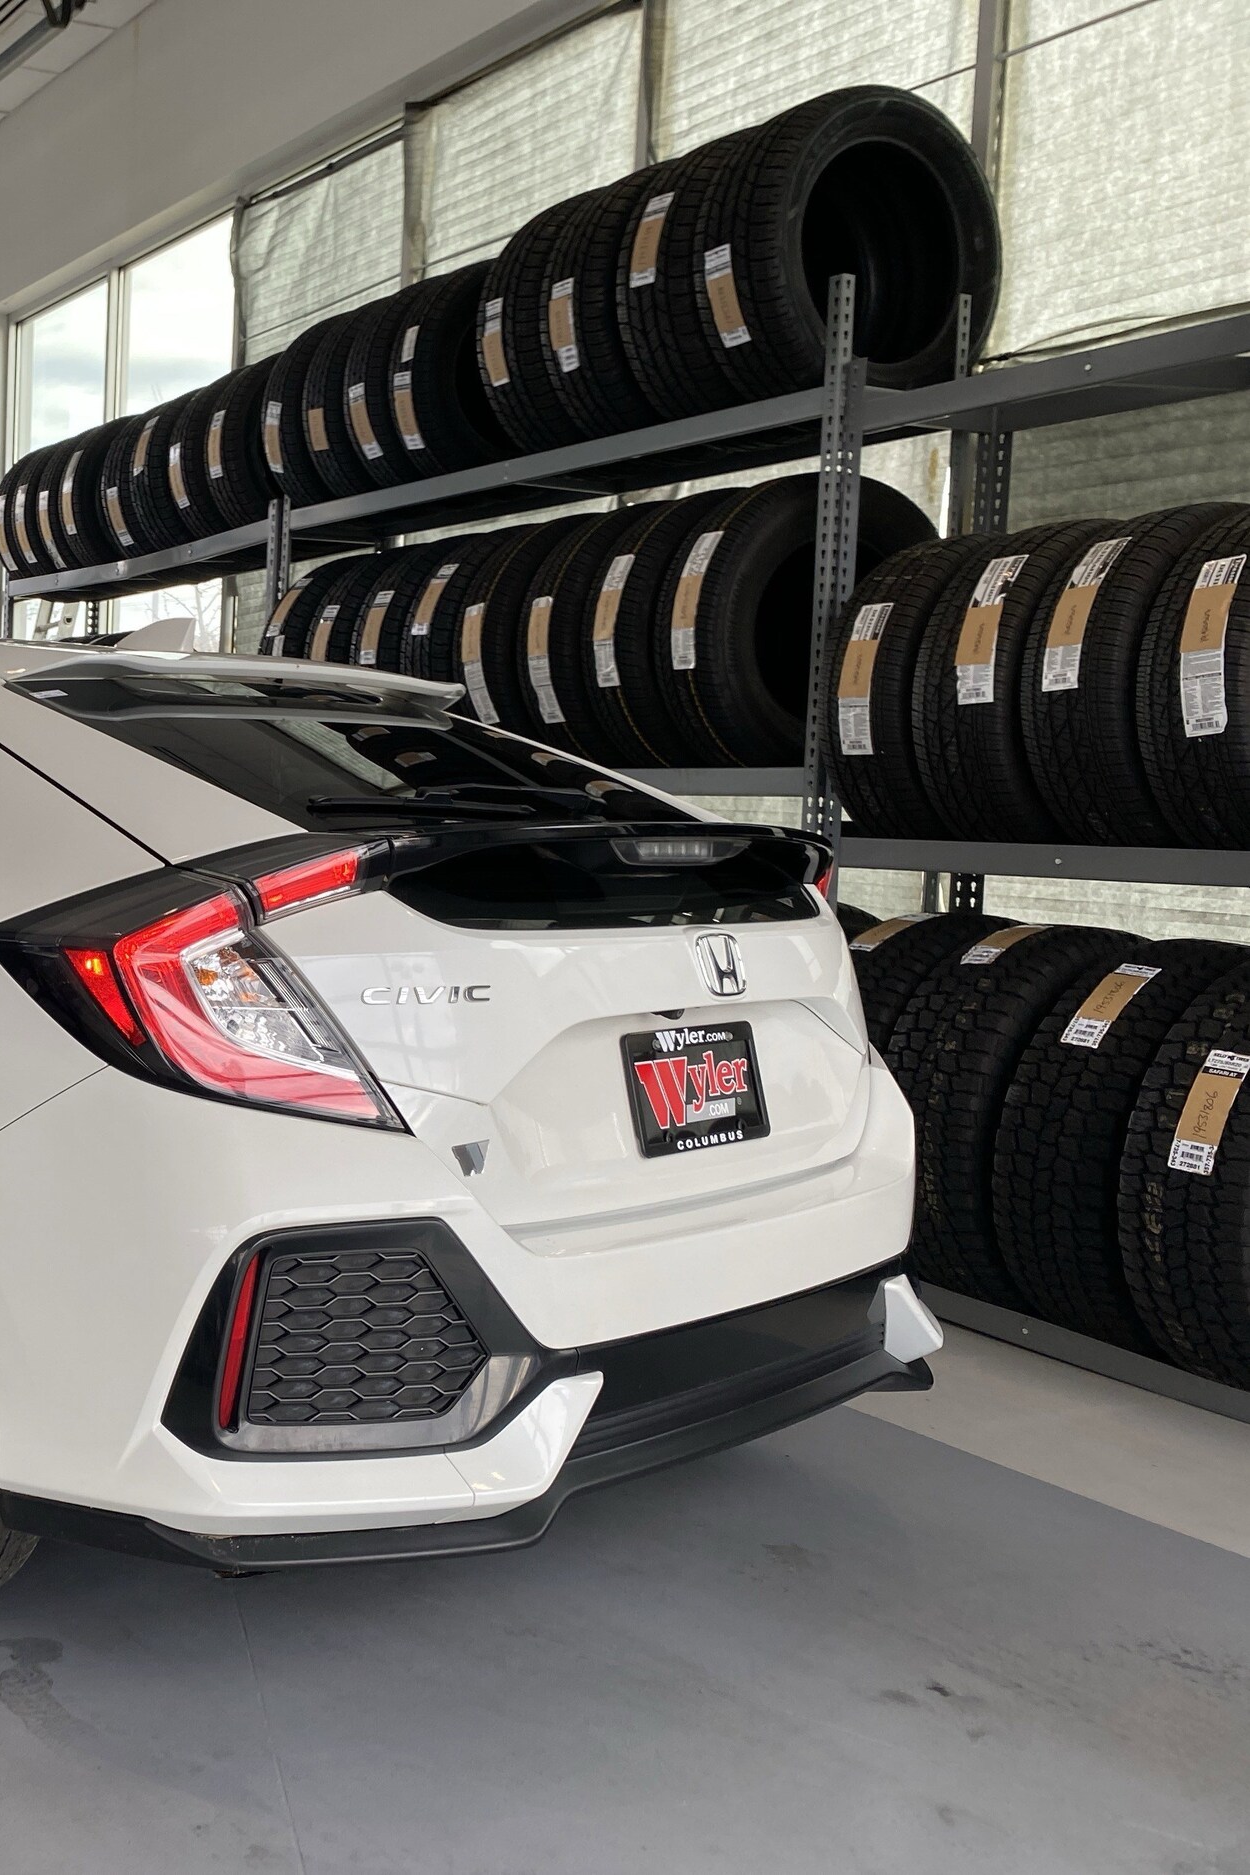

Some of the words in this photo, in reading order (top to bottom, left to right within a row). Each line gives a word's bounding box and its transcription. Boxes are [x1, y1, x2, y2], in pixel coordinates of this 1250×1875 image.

[361, 985, 491, 1006] CIVIC
[655, 1028, 726, 1052] Wyler.COM
[634, 1050, 748, 1129] Wyler
[676, 1129, 744, 1150] COLUMBUS
